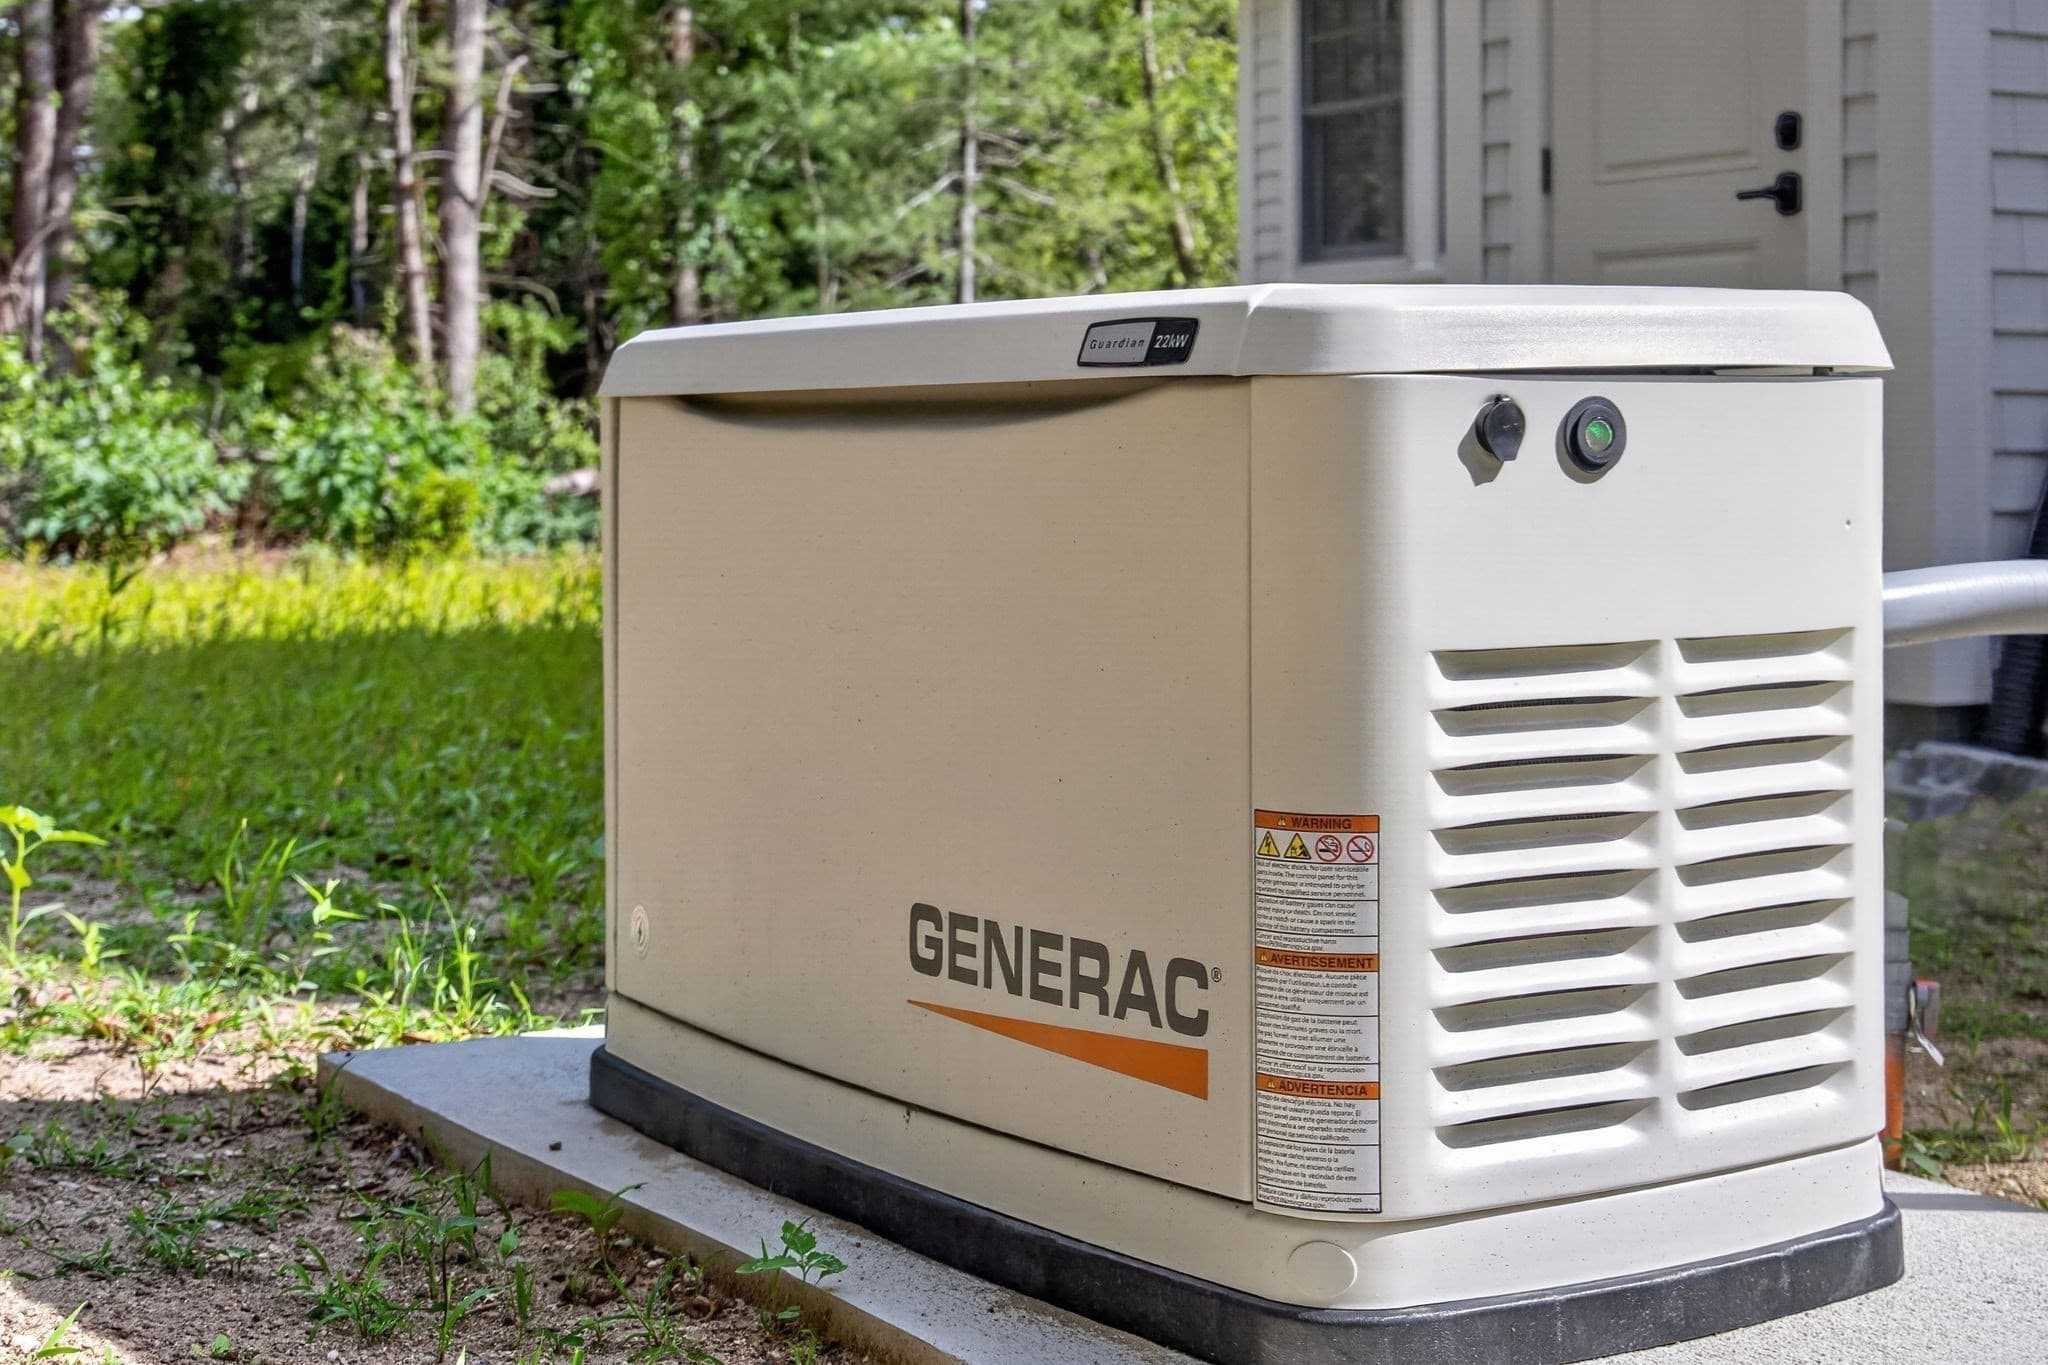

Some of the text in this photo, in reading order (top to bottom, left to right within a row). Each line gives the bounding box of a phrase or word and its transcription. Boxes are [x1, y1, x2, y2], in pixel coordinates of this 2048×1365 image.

[1090, 334, 1189, 350] Guardian 22kW
[1291, 816, 1352, 830] WARNING
[1270, 953, 1373, 968] AVERTISSEMENT
[1279, 1080, 1367, 1096] ADVERTENCIA
